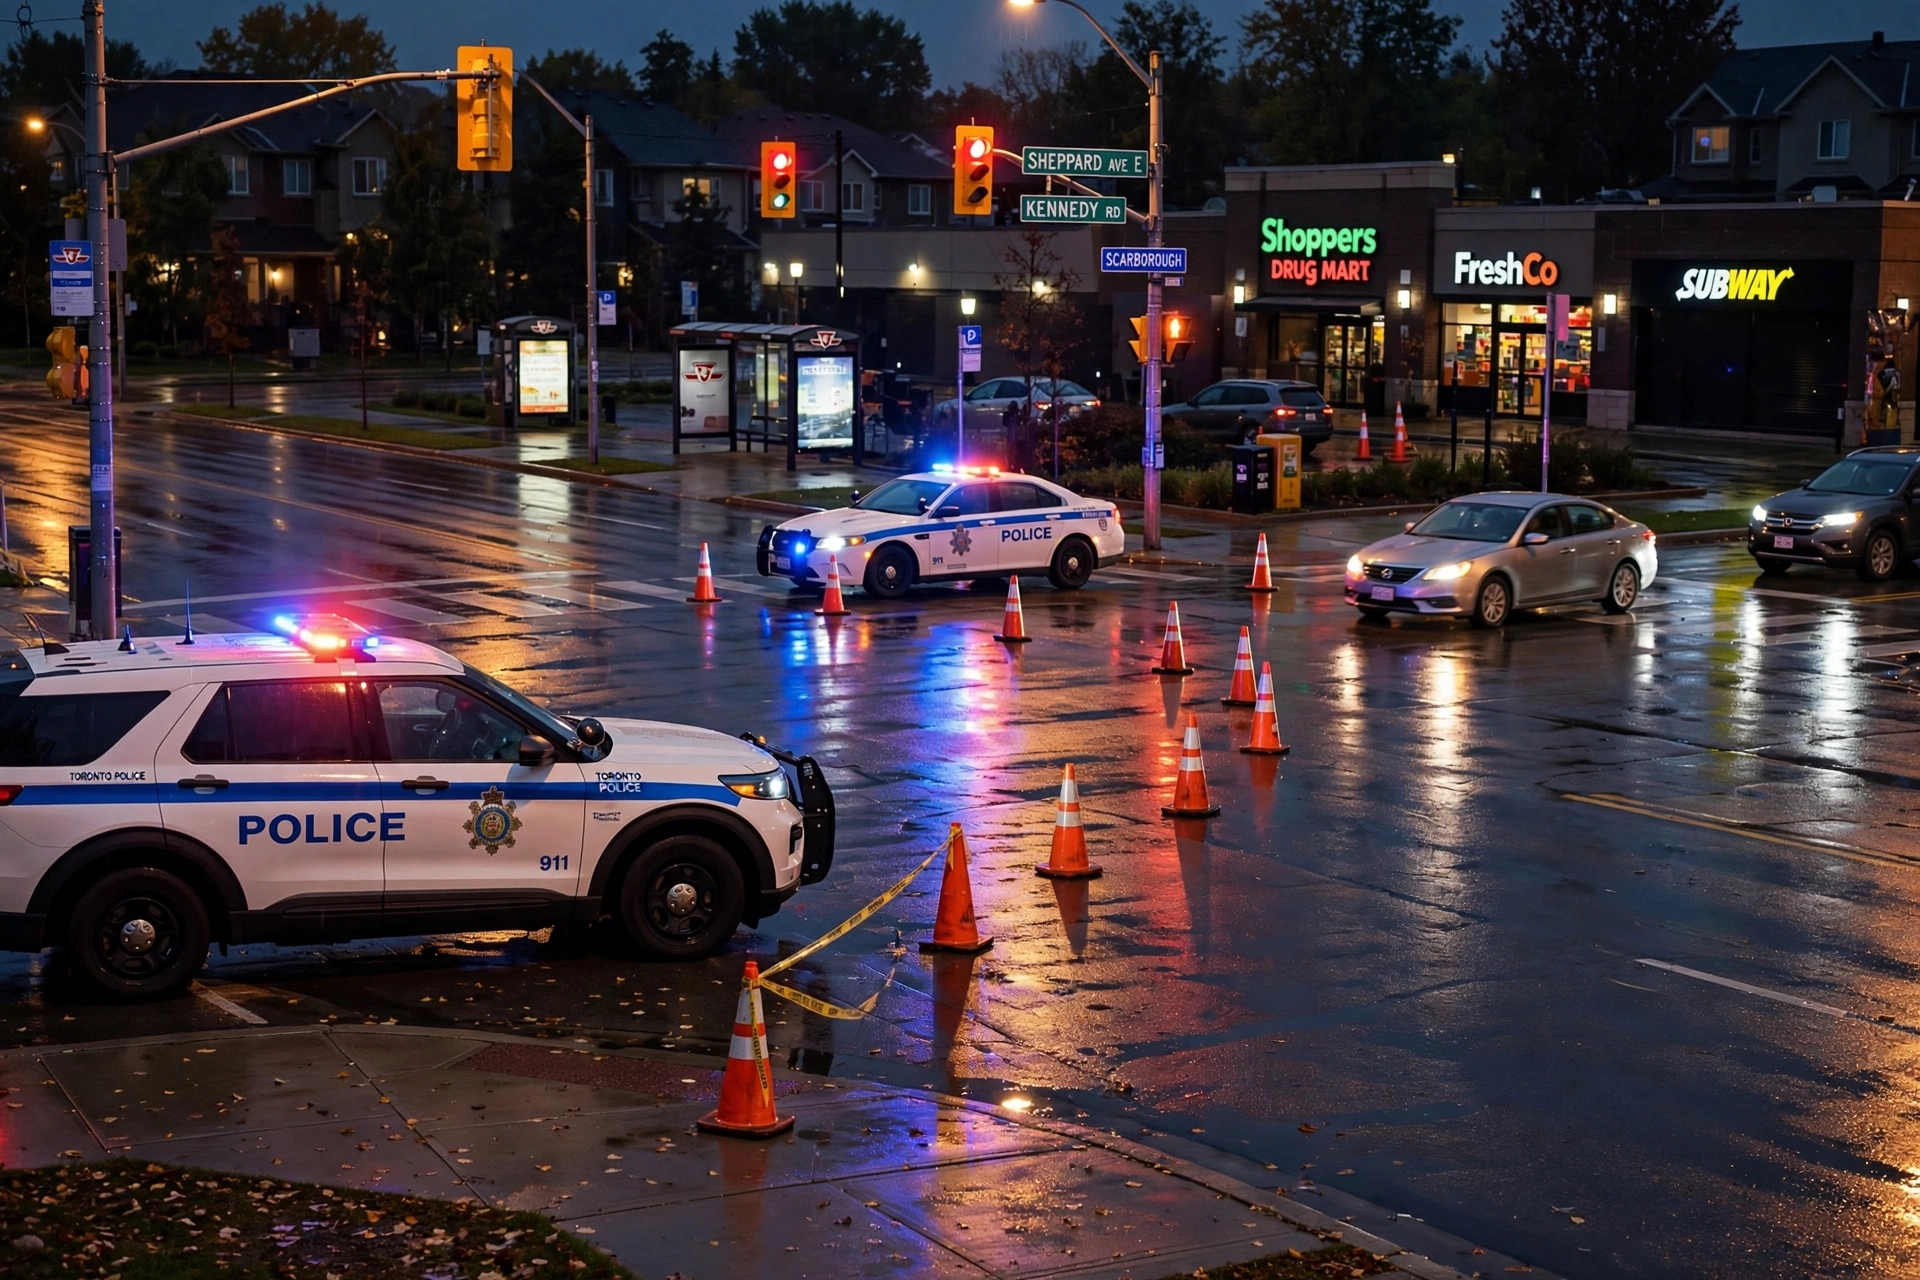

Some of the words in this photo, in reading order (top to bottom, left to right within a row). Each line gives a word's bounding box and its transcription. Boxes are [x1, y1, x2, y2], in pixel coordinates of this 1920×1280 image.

[1028, 152, 1102, 171] SHEPPARD
[1108, 158, 1128, 172] AVE
[1134, 156, 1142, 172] E
[1026, 200, 1099, 218] KENNEDY
[1105, 206, 1121, 218] RD
[1261, 217, 1377, 257] Shoppers
[1106, 252, 1182, 267] SCARBOROUGH
[1271, 259, 1317, 286] DRUG
[1321, 260, 1370, 280] MART
[1454, 252, 1558, 286] FreshCo
[1675, 266, 1795, 301] SUBWAY
[1001, 527, 1052, 542] POLICE
[69, 772, 112, 781] TORONTO
[114, 771, 146, 781] POLICE
[595, 772, 641, 781] TORONTO
[599, 783, 641, 793] POLICE
[238, 812, 406, 845] POLICE
[539, 855, 569, 871] 911
